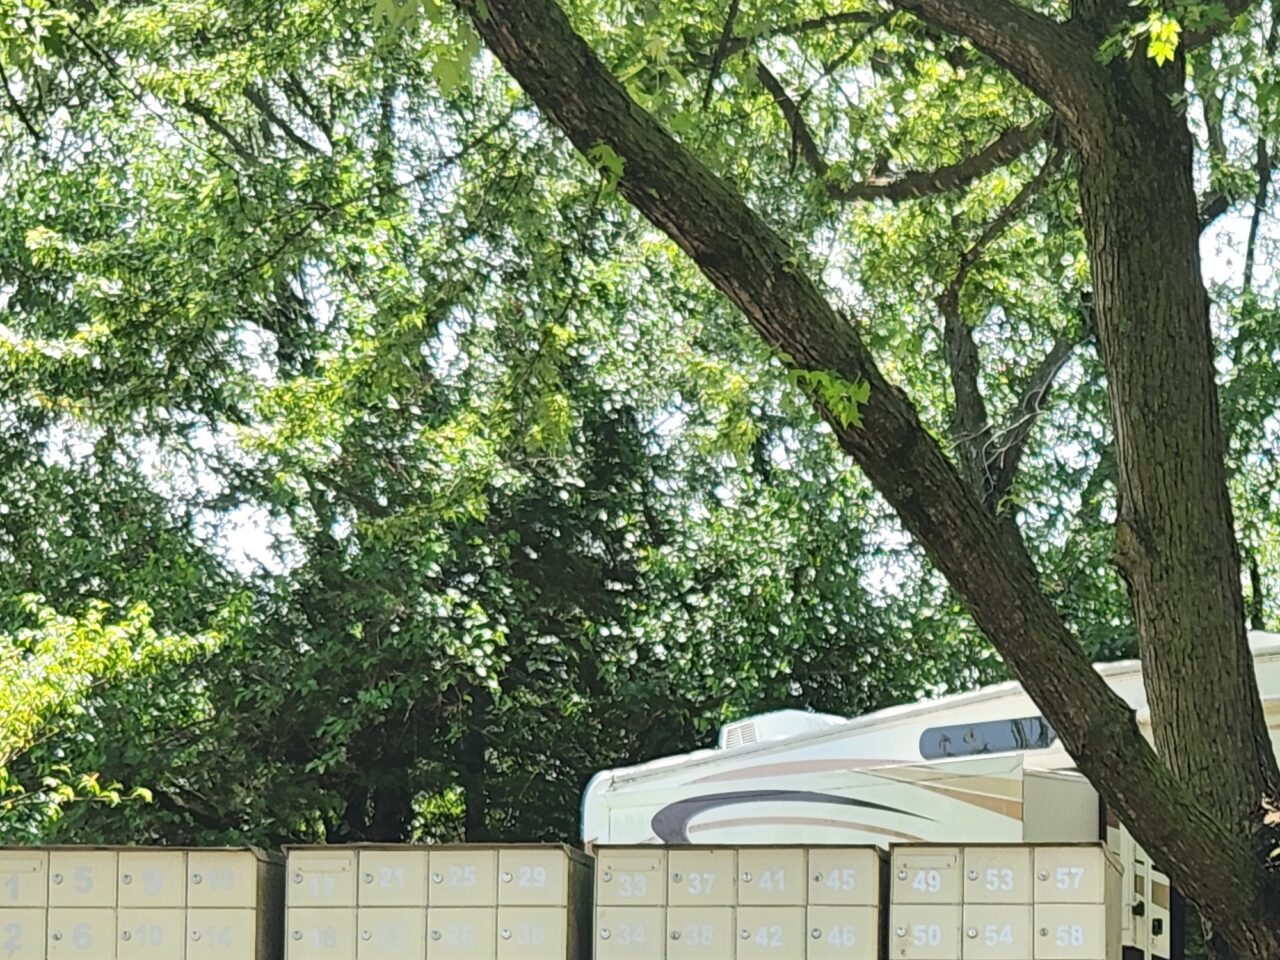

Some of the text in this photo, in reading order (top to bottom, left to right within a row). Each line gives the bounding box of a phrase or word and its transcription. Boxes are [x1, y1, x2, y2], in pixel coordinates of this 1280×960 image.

[73, 865, 94, 893] 5
[142, 868, 163, 896] 9
[379, 867, 405, 888] 21
[448, 866, 477, 888] 25
[517, 867, 546, 888] 29
[619, 875, 647, 897] 33
[687, 873, 716, 895] 37
[758, 870, 785, 892] 41
[826, 869, 856, 891] 45
[912, 871, 941, 893] 49
[986, 868, 1014, 891] 53
[1056, 867, 1085, 890] 57
[3, 922, 23, 953] 2
[72, 922, 93, 950] 6
[135, 924, 163, 946] 10
[618, 924, 646, 946] 34
[687, 924, 714, 945] 38
[754, 926, 783, 947] 42
[827, 926, 856, 947] 46
[912, 924, 941, 945] 50
[984, 925, 1013, 946] 54
[1056, 925, 1084, 947] 58
